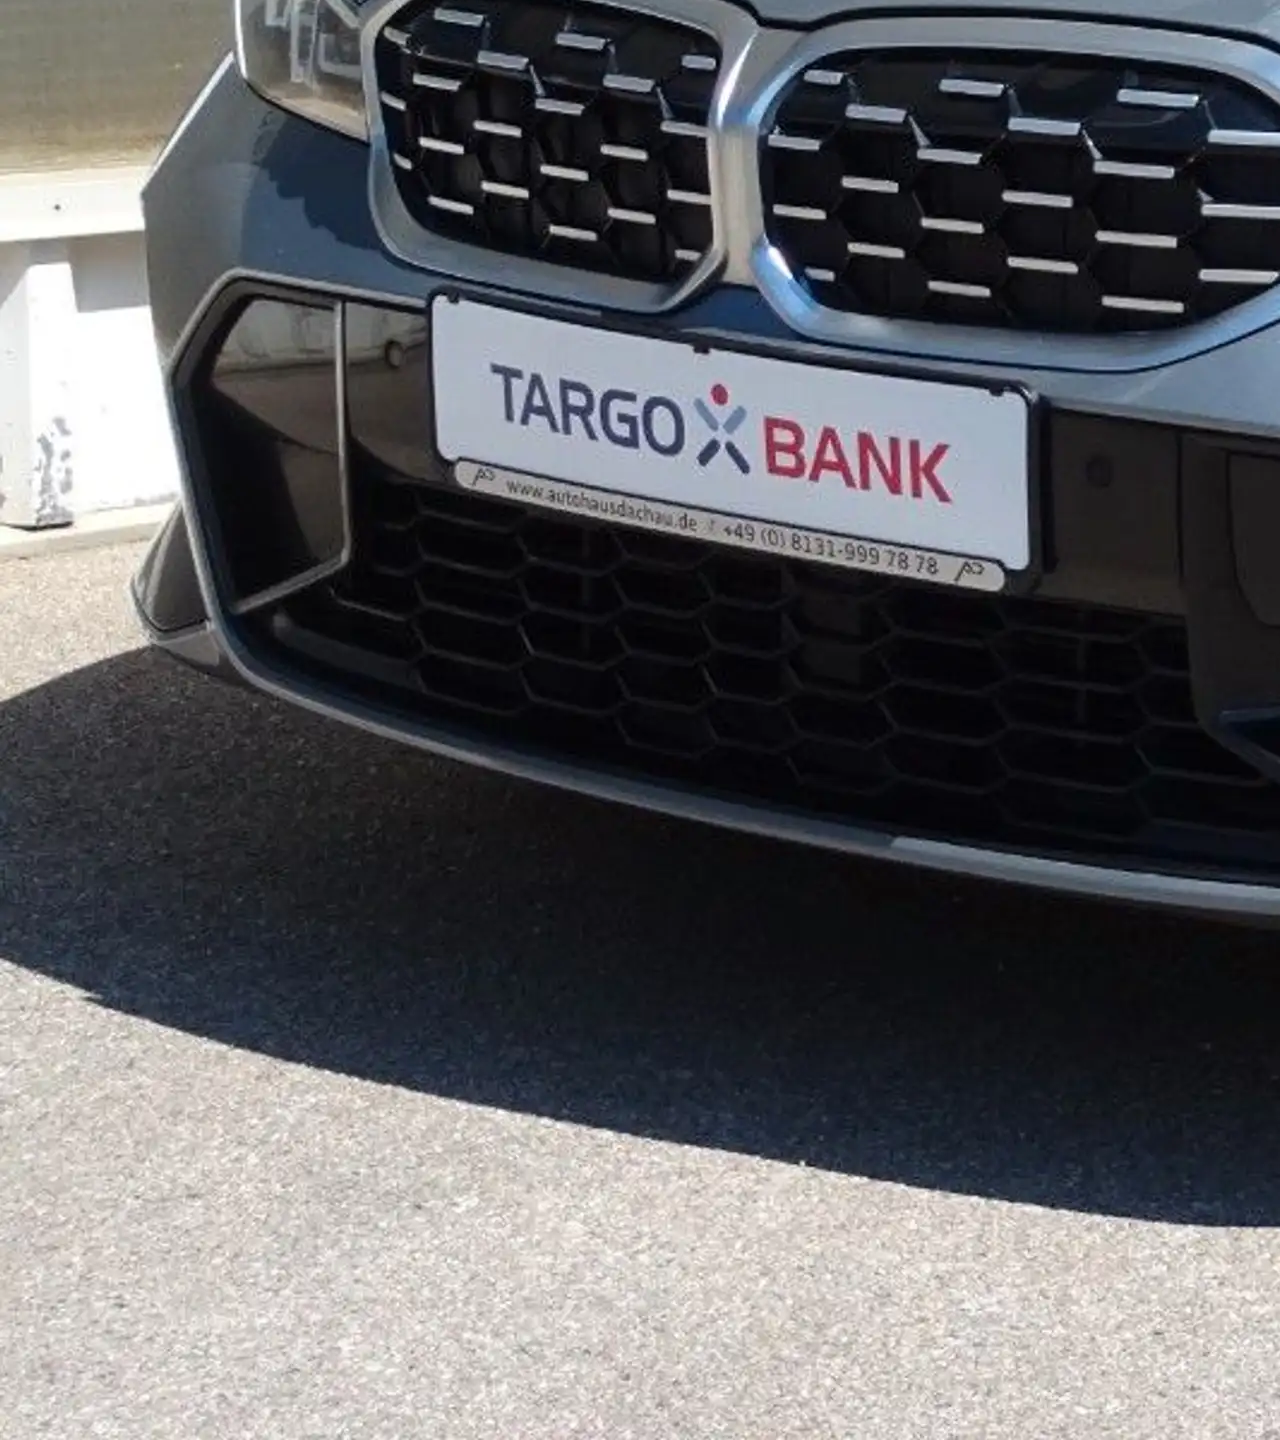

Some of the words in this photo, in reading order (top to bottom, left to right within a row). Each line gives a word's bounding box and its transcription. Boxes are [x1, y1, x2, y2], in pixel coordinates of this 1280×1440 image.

[489, 363, 686, 458] TARGO
[763, 416, 954, 504] BANK
[505, 479, 699, 534] www.autohausdachau.de
[760, 526, 787, 550] (0)
[790, 532, 880, 566] 8131-999
[885, 549, 910, 571] 78
[915, 554, 940, 576] 78
